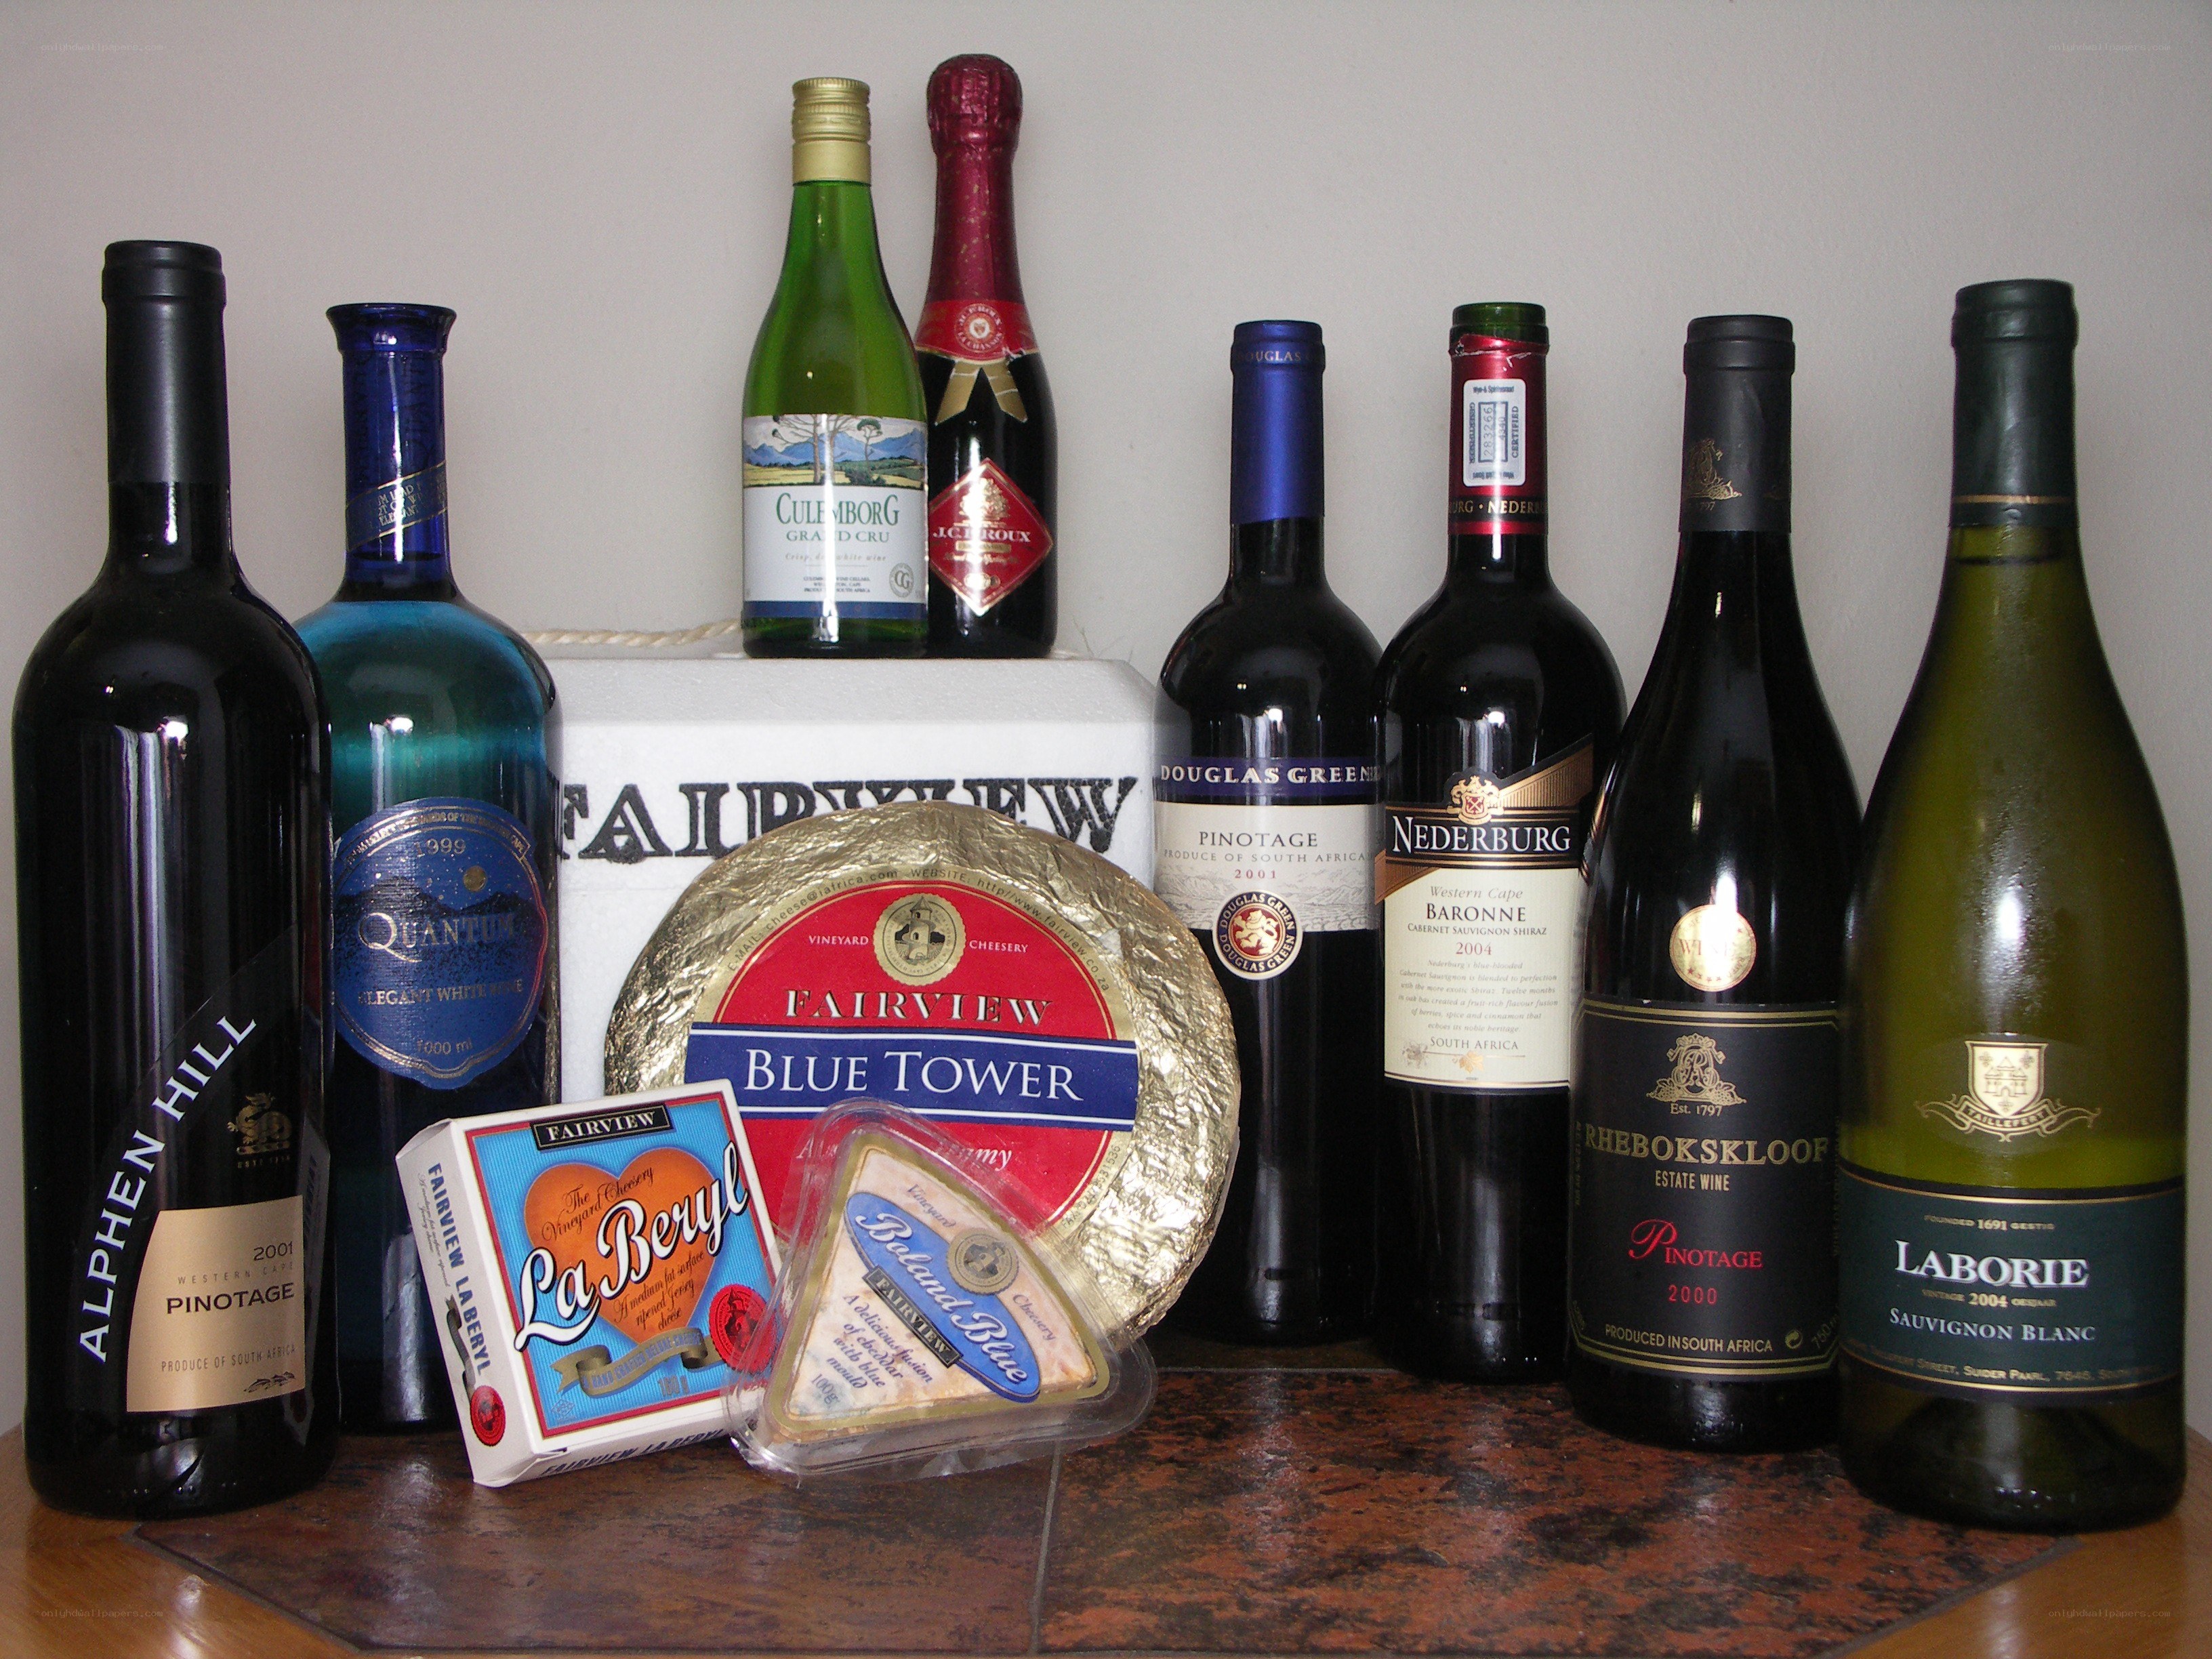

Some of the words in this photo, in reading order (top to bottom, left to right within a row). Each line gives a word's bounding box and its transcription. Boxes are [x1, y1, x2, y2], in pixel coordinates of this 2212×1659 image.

[1483, 407, 1492, 457] 283266
[786, 531, 851, 541] GRAD
[855, 530, 890, 543] CRU
[1161, 765, 1280, 783] DOUGLAS
[1287, 765, 1371, 783] GREEN
[413, 838, 466, 857] 1999
[1199, 831, 1317, 847] PINOTAGE
[1392, 815, 1572, 854] NEDERBURG
[1164, 849, 1216, 862] PRODUCE
[1225, 853, 1243, 862] OF
[1252, 853, 1307, 863] SOUTH
[1315, 852, 1366, 863] AFRICA
[1235, 869, 1277, 880] 2001
[1430, 886, 1482, 899] Western
[1488, 886, 1523, 901] Cape
[727, 931, 762, 971] E-MAIL:
[766, 869, 898, 932] cheese@iafrica.com
[1221, 893, 1265, 930] DOUGLAS
[1267, 895, 1296, 930] GREEN
[1426, 903, 1527, 922] BARONNE
[359, 912, 514, 962] QUANTUM
[808, 935, 869, 945] VINEYARD
[968, 939, 1029, 953] CHEESERY
[1408, 923, 1450, 935] CABERNET
[1452, 924, 1511, 936] SAUVIGNON
[1513, 926, 1547, 936] SHIRAZ
[1219, 934, 1265, 972] DOUGLAS
[1266, 935, 1296, 969] GREEN
[1455, 941, 1492, 956] 2004
[1429, 972, 1467, 981] Sauvignon
[1478, 973, 1508, 981] blended
[1520, 974, 1557, 983] perfection
[1473, 961, 1523, 969] blue-blooded
[358, 987, 433, 1006] ELEGANT
[436, 983, 486, 1003] WHITE
[489, 979, 524, 998] WINE
[785, 989, 1054, 1026] FAIRVIEW
[1431, 997, 1457, 1005] created
[1505, 1000, 1534, 1008] flavour
[1535, 1000, 1558, 1008] fusion
[1446, 1011, 1465, 1020] spice
[416, 1039, 451, 1055] 1000
[1430, 1037, 1469, 1050] SOUTH
[1475, 1038, 1519, 1050] AFRICA
[743, 1048, 867, 1092] BLUE
[884, 1050, 1084, 1101] TOWER
[1670, 1103, 1691, 1115] Est.
[1696, 1103, 1723, 1117] 1797
[1967, 1107, 2045, 1128] TAILLEFERT
[546, 1110, 657, 1142] FAIRVIEW
[1585, 1123, 1829, 1166] RHEBOKSKLOOF
[79, 1129, 165, 1362] ALPHEN
[152, 1017, 256, 1122] HILL
[1655, 1170, 1696, 1190] ESTATE
[1700, 1173, 1730, 1191] WINE
[542, 1186, 603, 1242] Vineyard
[600, 1166, 655, 1203] Cheesery
[563, 1184, 591, 1214] The
[905, 1183, 956, 1229] Vineyard
[428, 1162, 465, 1269] FAIRVIEW
[1977, 1218, 2008, 1231] 1691
[253, 1241, 293, 1261] 2001
[514, 1248, 603, 1353] La
[595, 1141, 750, 1300] Beryl
[1629, 1218, 1763, 1269] PINOTAGE
[178, 1270, 251, 1285] WESTERN
[263, 1261, 293, 1275] CAPE
[1896, 1240, 2091, 1288] LABORIE
[166, 1282, 295, 1315] PINOTAGE
[455, 1275, 473, 1307] LA
[613, 1293, 629, 1323] A
[630, 1282, 665, 1307] medium
[664, 1267, 675, 1288] fat
[635, 1293, 667, 1330] ripened
[667, 1277, 695, 1311] Jersey
[855, 1212, 972, 1314] Boland
[951, 1312, 1028, 1385] Blue
[1668, 1285, 1718, 1305] 2000
[1968, 1292, 2009, 1309] 2004
[657, 1307, 683, 1331] cheese
[874, 1275, 951, 1354] FAIRVIEW
[1012, 1293, 1057, 1343] Cheesery
[1889, 1307, 2013, 1340] SAUVIGNON
[2021, 1324, 2096, 1341] BLANC
[463, 1307, 491, 1376] BERYL
[842, 1294, 856, 1307] A
[855, 1300, 897, 1346] delicious
[893, 1342, 933, 1385] fusion
[843, 1322, 857, 1338] of
[855, 1328, 904, 1379] cheddar
[1605, 1324, 1665, 1347] PRODUCED
[1726, 1339, 1773, 1353] AFRICA
[161, 1357, 208, 1372] PRODUCE
[214, 1356, 226, 1368] OF
[231, 1351, 262, 1367] SOUTH
[266, 1344, 295, 1360] AFRICA
[825, 1356, 868, 1390] mould
[832, 1336, 859, 1364] with
[859, 1359, 886, 1389] blue
[591, 1370, 614, 1389] HAND
[812, 1373, 839, 1405] 100g
